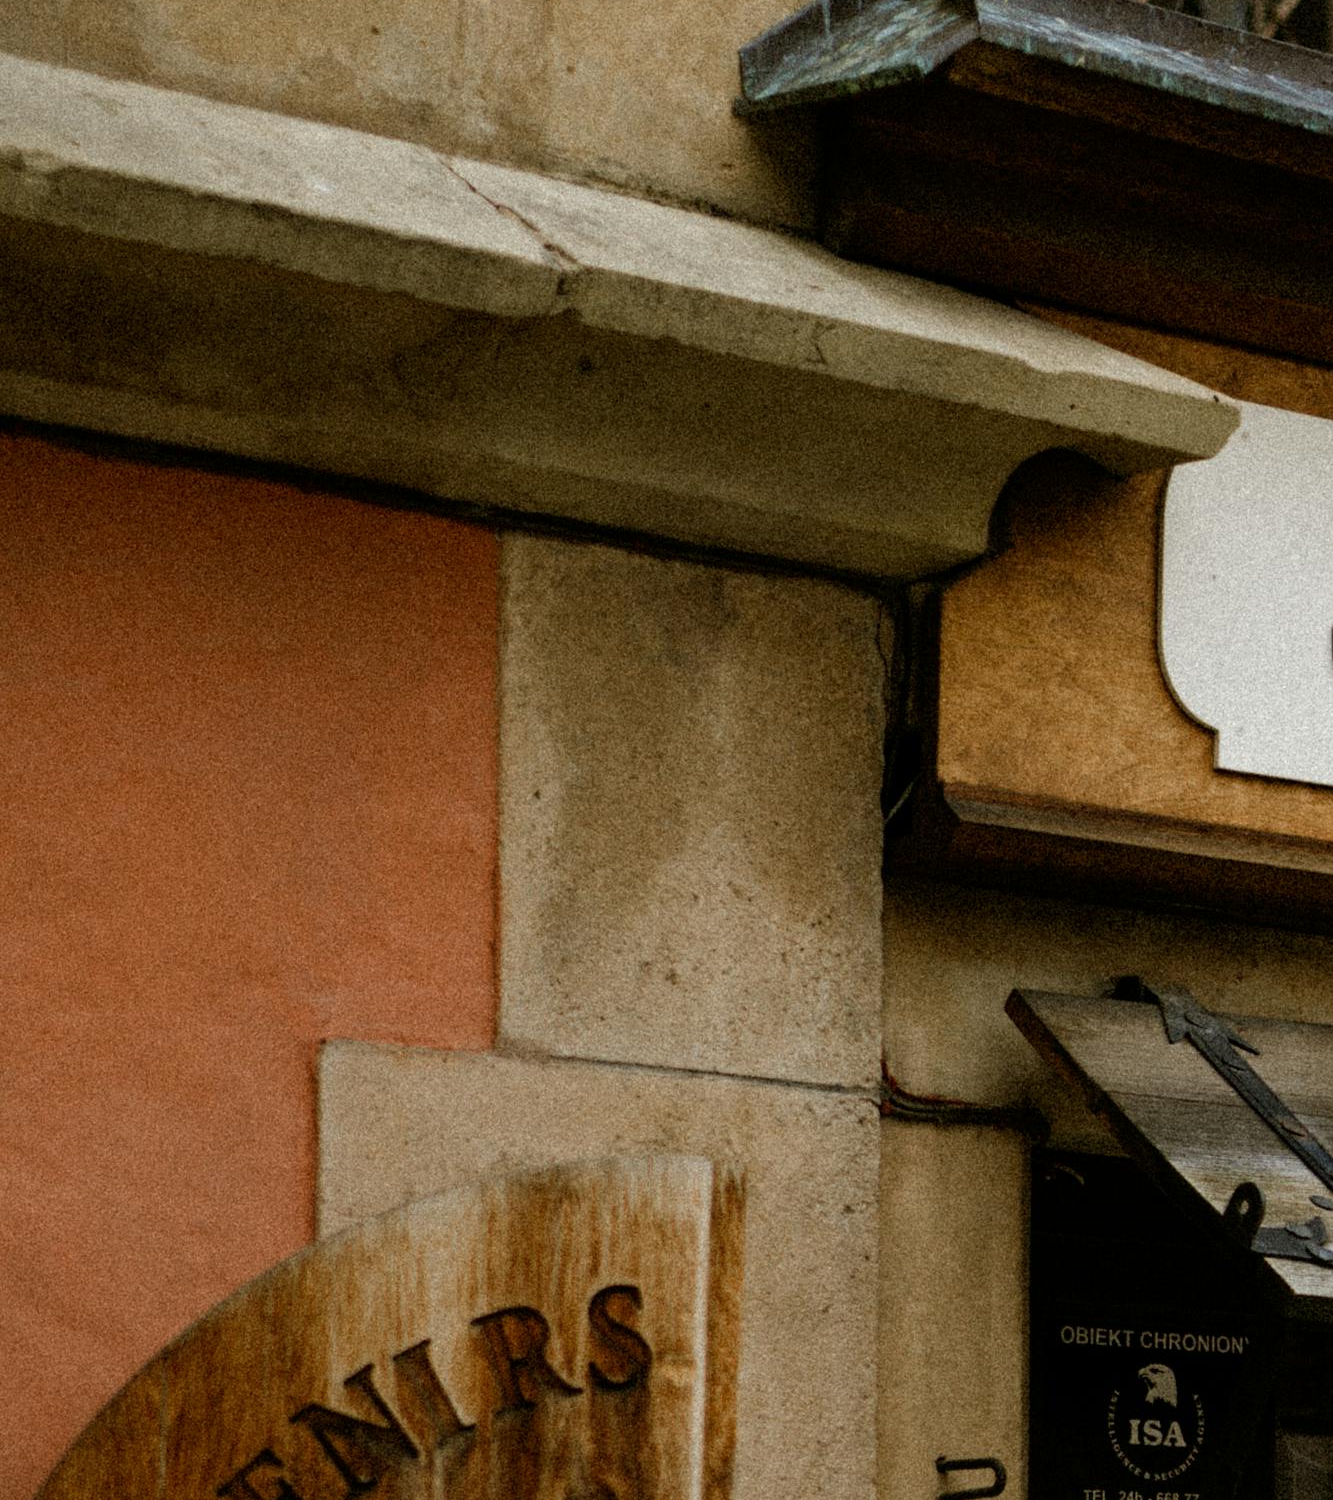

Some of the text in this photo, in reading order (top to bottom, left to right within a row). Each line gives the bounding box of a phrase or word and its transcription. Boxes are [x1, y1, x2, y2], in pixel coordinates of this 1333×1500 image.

[1060, 1325, 1251, 1355] OBIEKT CHRONION
[1128, 1418, 1188, 1448] ISA
